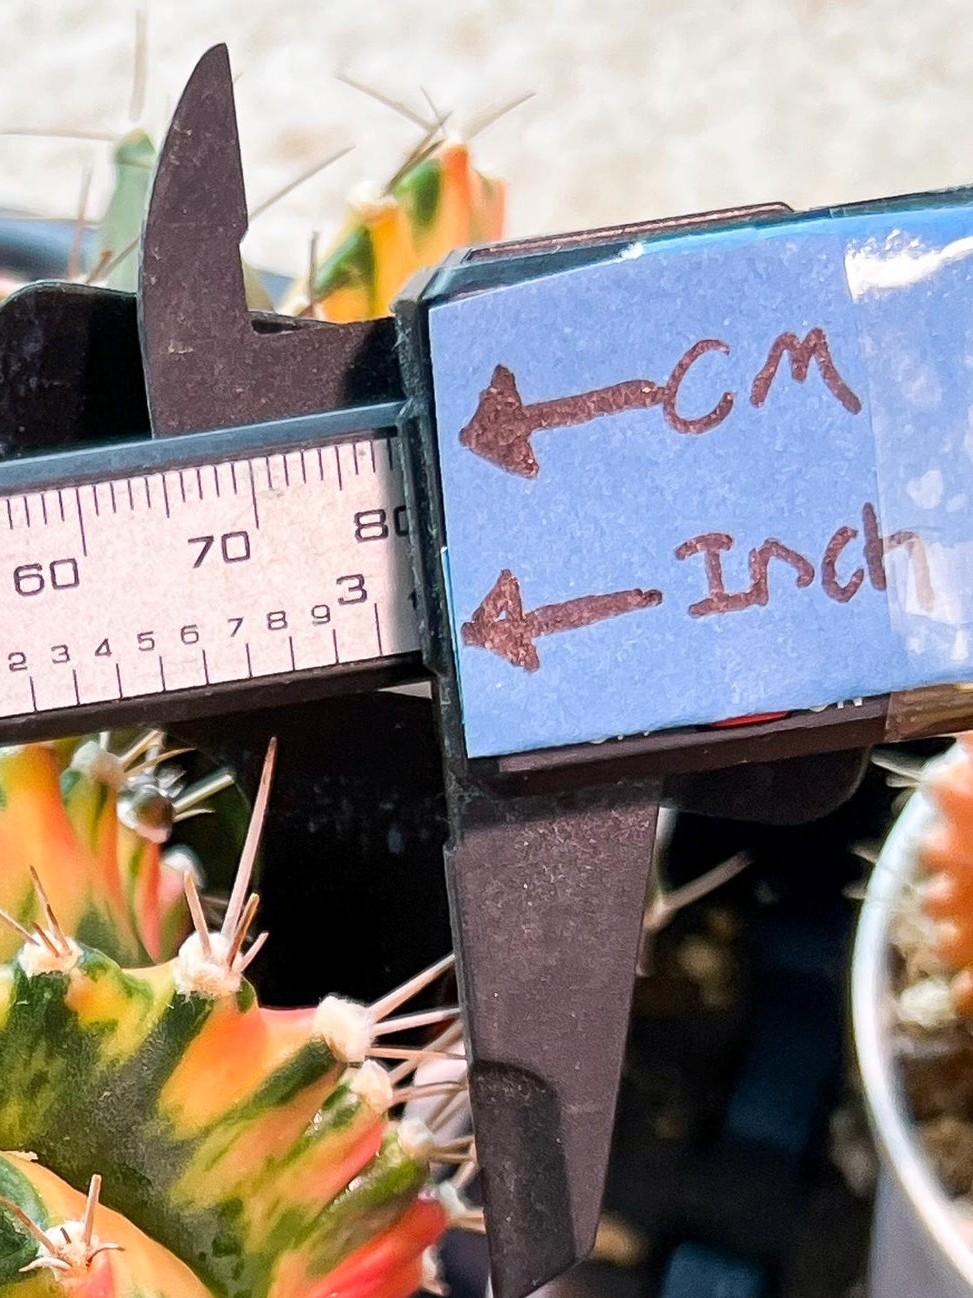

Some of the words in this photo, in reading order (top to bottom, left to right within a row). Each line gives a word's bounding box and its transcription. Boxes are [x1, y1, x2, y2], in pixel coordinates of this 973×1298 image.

[664, 326, 862, 434] CM
[13, 558, 80, 597] 60
[187, 530, 251, 568] 70
[675, 502, 933, 617] Inch
[7, 651, 28, 672] 2
[51, 644, 71, 664] 3
[94, 638, 112, 657] 4
[136, 630, 155, 652] 5
[180, 624, 200, 645] 6
[227, 617, 244, 637] 7
[266, 610, 288, 631] 8
[311, 604, 331, 625] 9
[336, 573, 368, 605] 3
